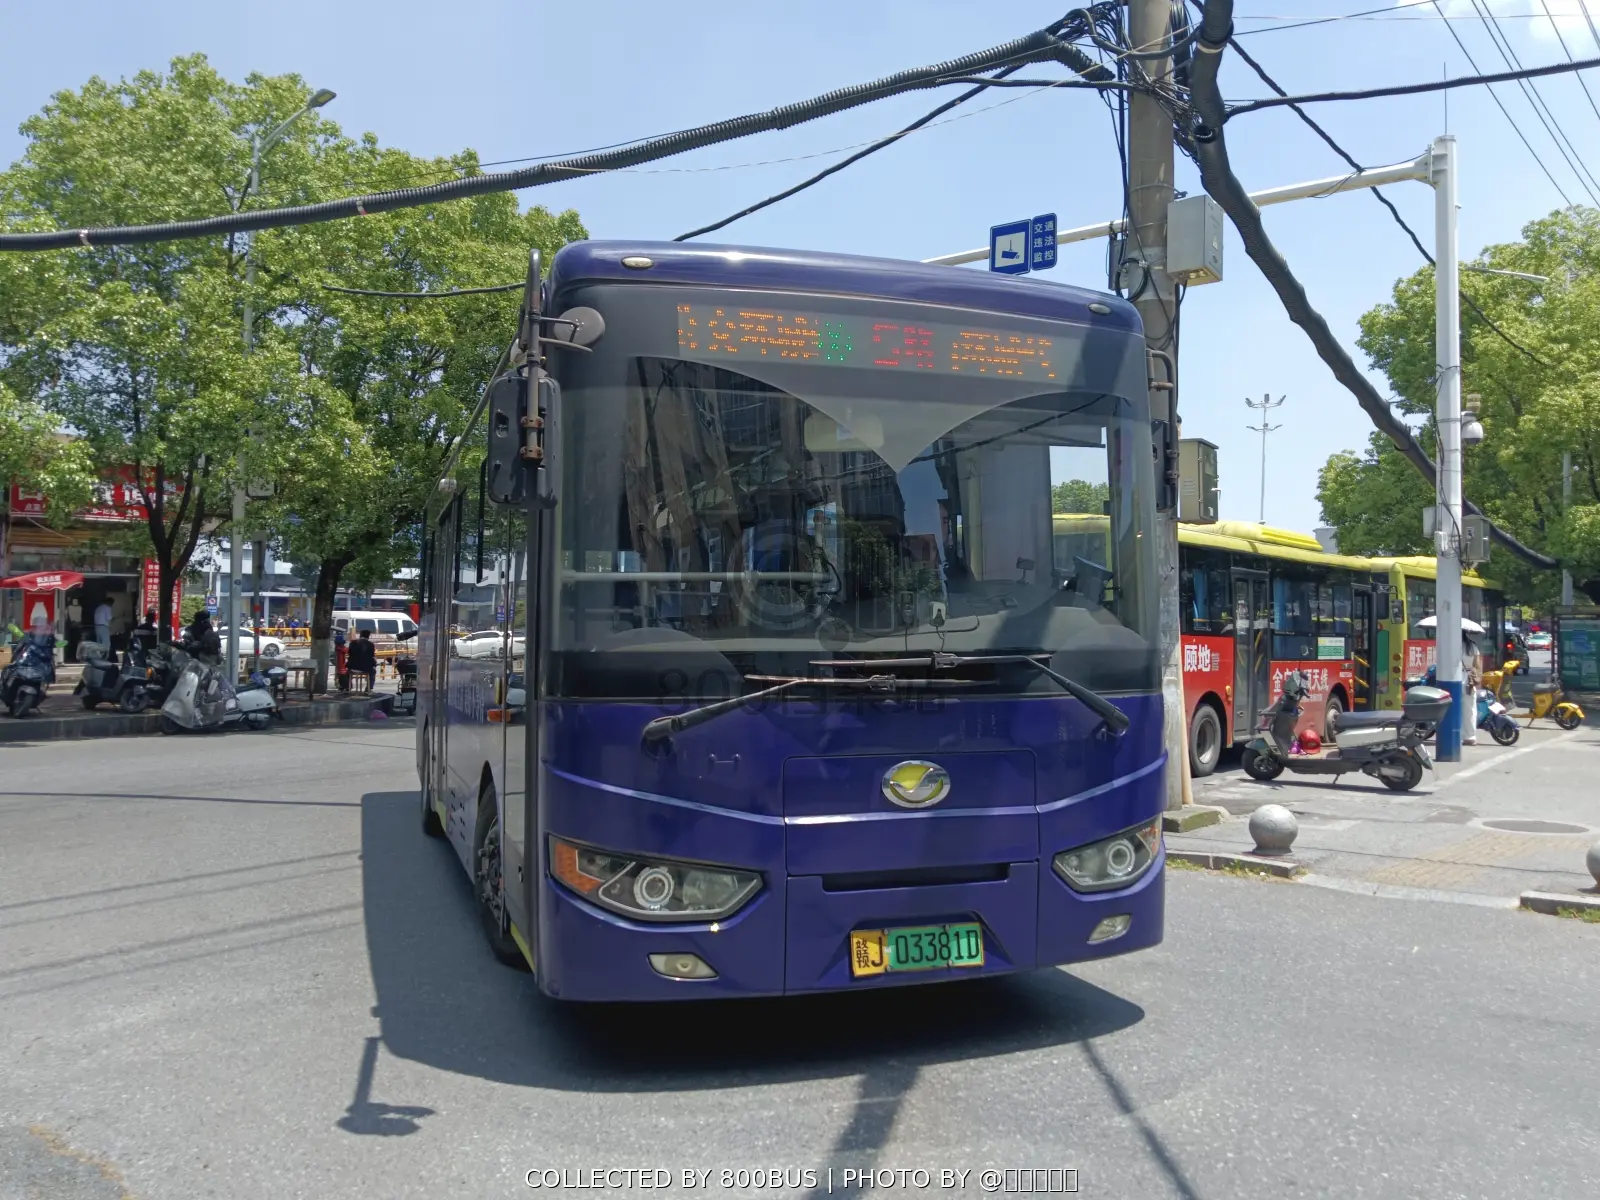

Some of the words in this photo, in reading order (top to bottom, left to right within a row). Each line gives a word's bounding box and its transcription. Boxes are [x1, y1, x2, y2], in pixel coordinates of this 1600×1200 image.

[1033, 220, 1055, 234] 交通
[1033, 235, 1055, 249] 违法
[1033, 249, 1055, 263] 监控
[855, 936, 884, 969] 赣J
[895, 929, 980, 965] 03381D
